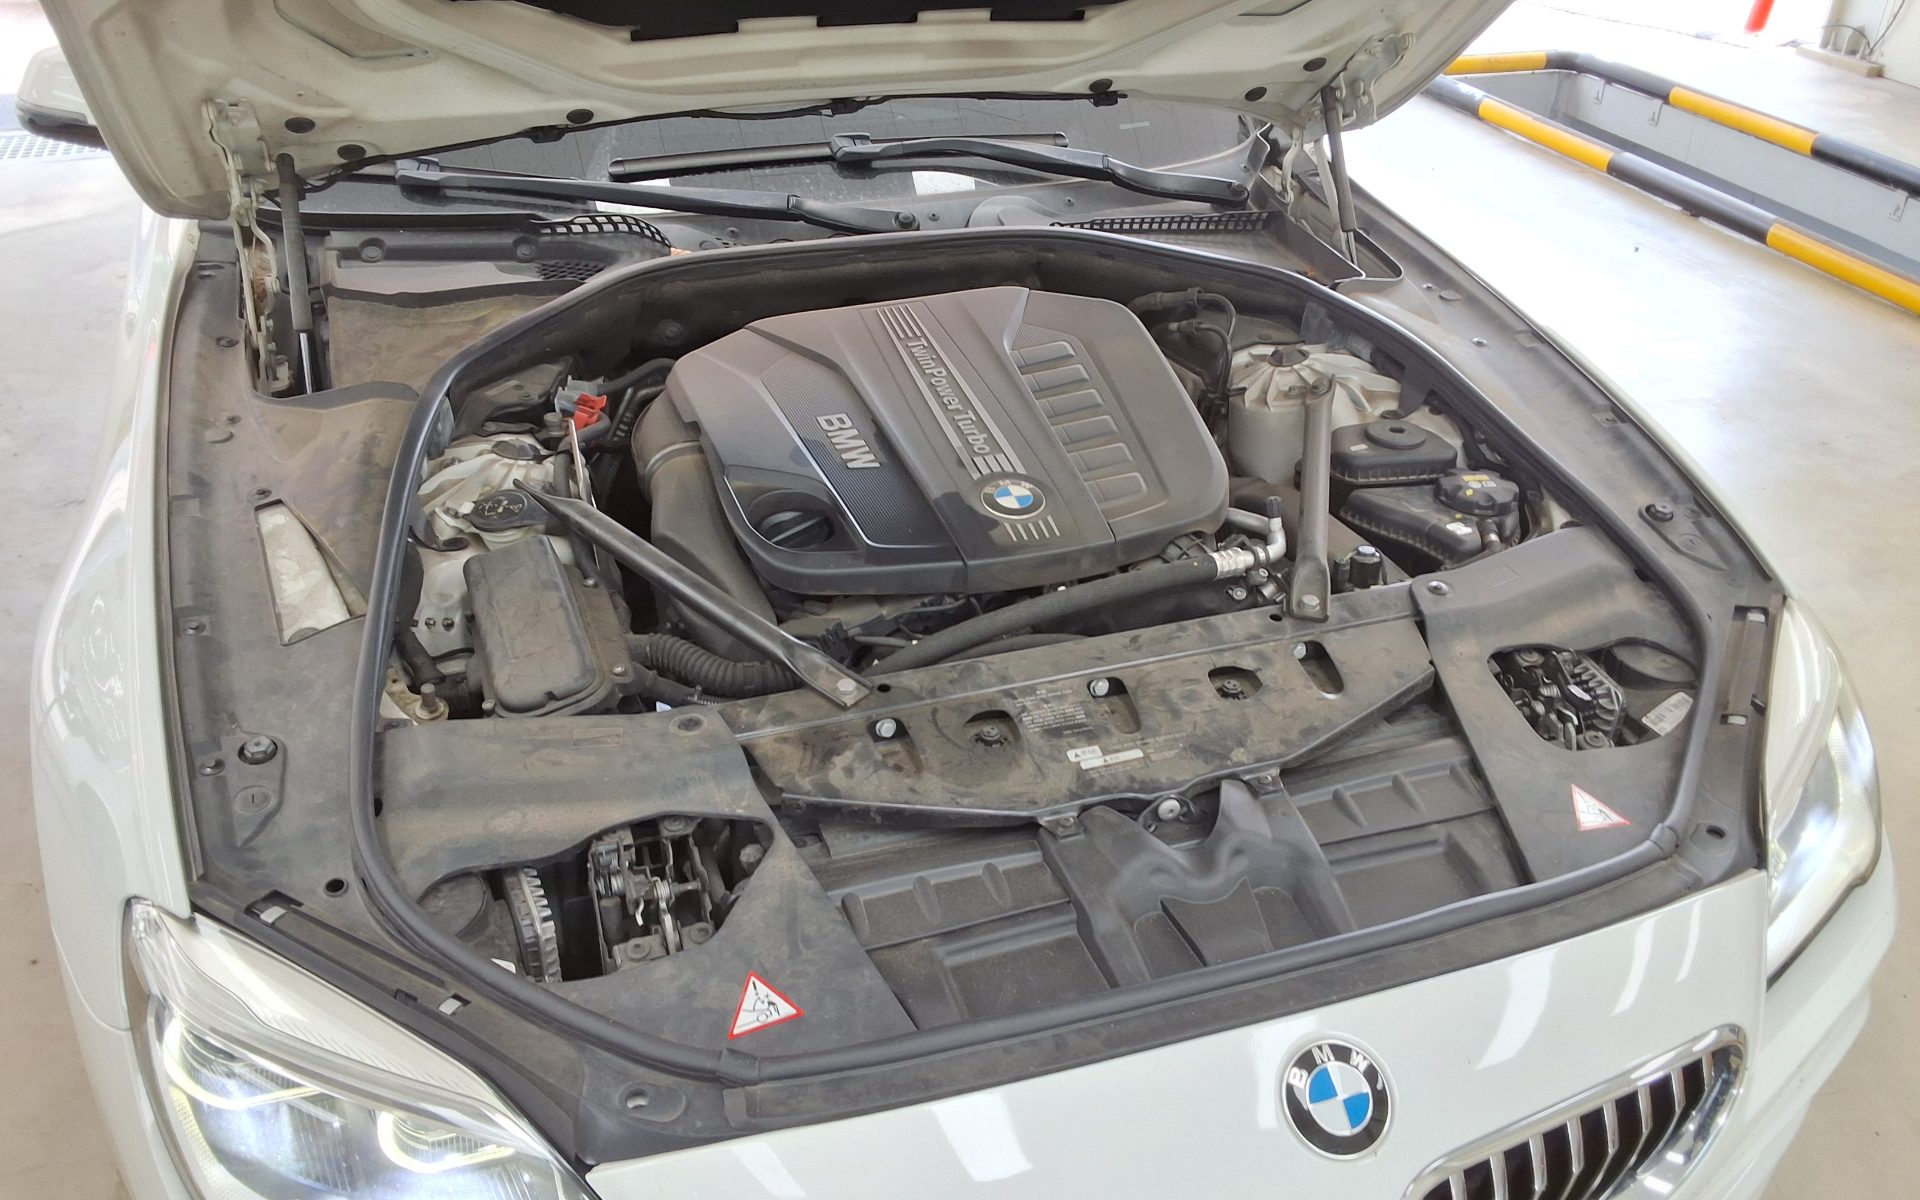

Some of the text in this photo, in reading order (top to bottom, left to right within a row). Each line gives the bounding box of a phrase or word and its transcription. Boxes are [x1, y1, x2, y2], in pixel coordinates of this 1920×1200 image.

[907, 337, 990, 454] TwinPower Turbo
[816, 413, 880, 469] BMW
[1287, 1043, 1371, 1090] BMW
